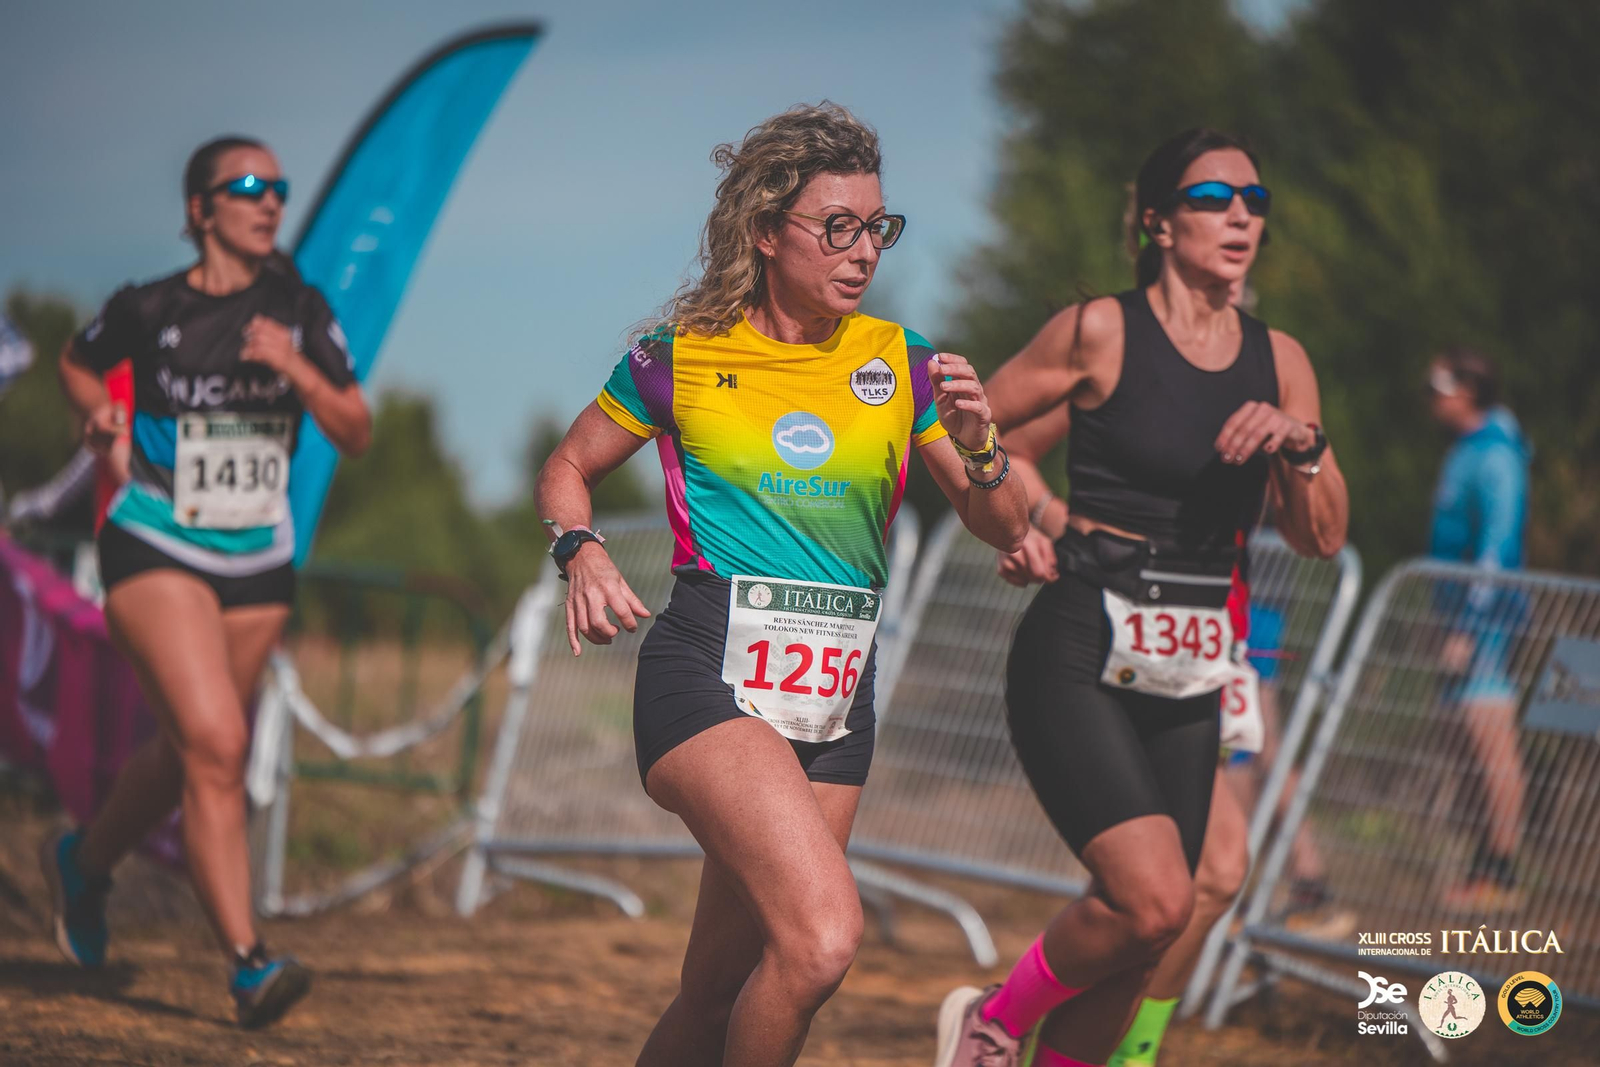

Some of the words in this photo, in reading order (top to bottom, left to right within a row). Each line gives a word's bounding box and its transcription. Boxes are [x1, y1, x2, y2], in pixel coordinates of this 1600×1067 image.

[862, 388, 889, 396] TLKS
[192, 456, 281, 493] 1430
[757, 471, 851, 497] AireSur
[784, 588, 854, 613] ITÁLICA
[764, 624, 798, 633] TOLOKOS
[816, 629, 841, 637] FITNESS
[773, 617, 797, 625] REYES
[797, 619, 828, 628] SÁNCHEZ
[1125, 613, 1222, 661] 1343
[743, 640, 861, 698] 1256
